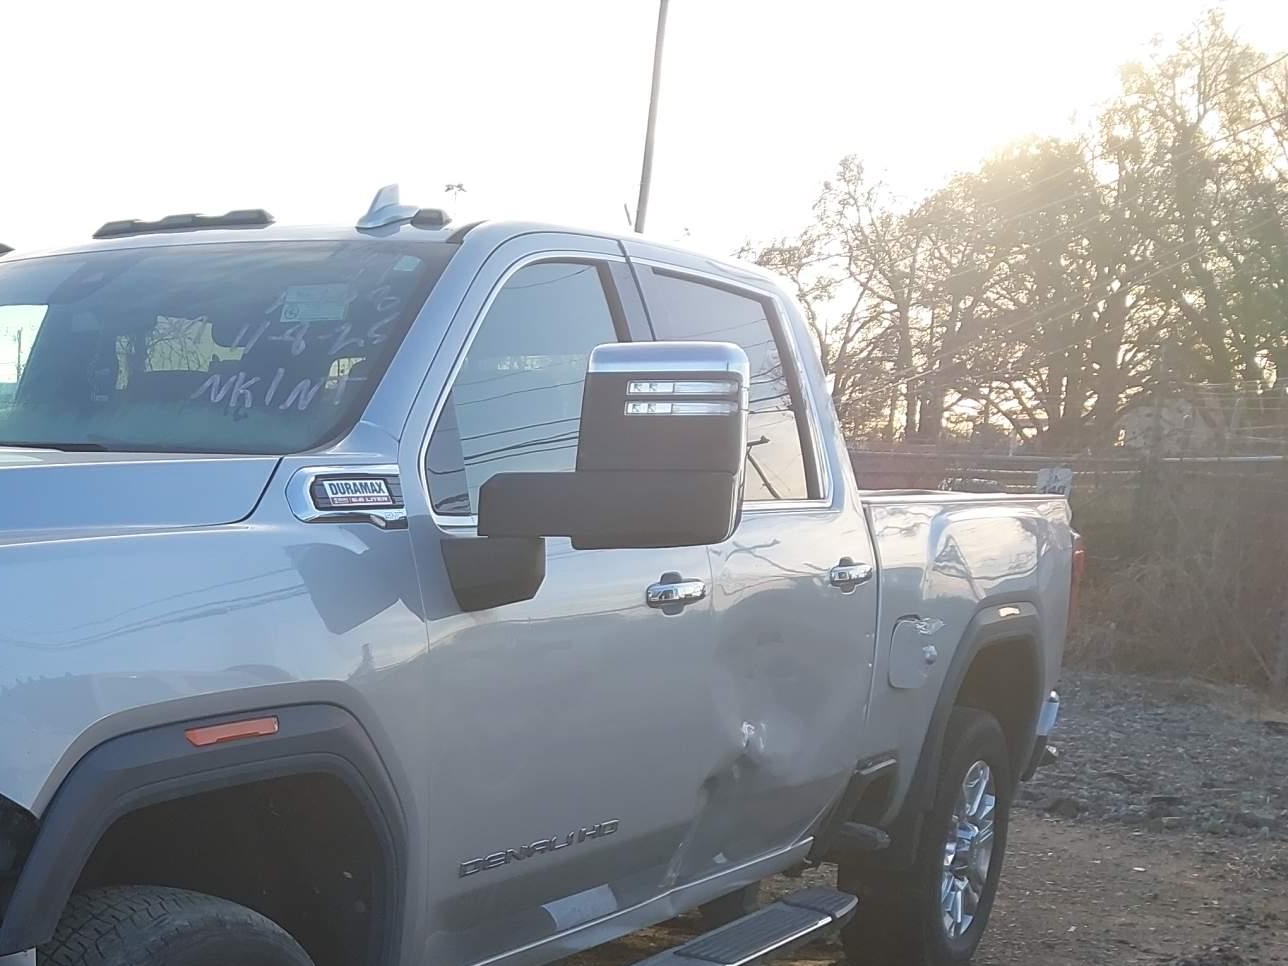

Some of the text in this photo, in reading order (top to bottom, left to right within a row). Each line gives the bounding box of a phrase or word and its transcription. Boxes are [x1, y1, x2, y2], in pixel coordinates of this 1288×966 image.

[329, 482, 386, 496] DURAMAX
[460, 819, 621, 878] DENALI HD
